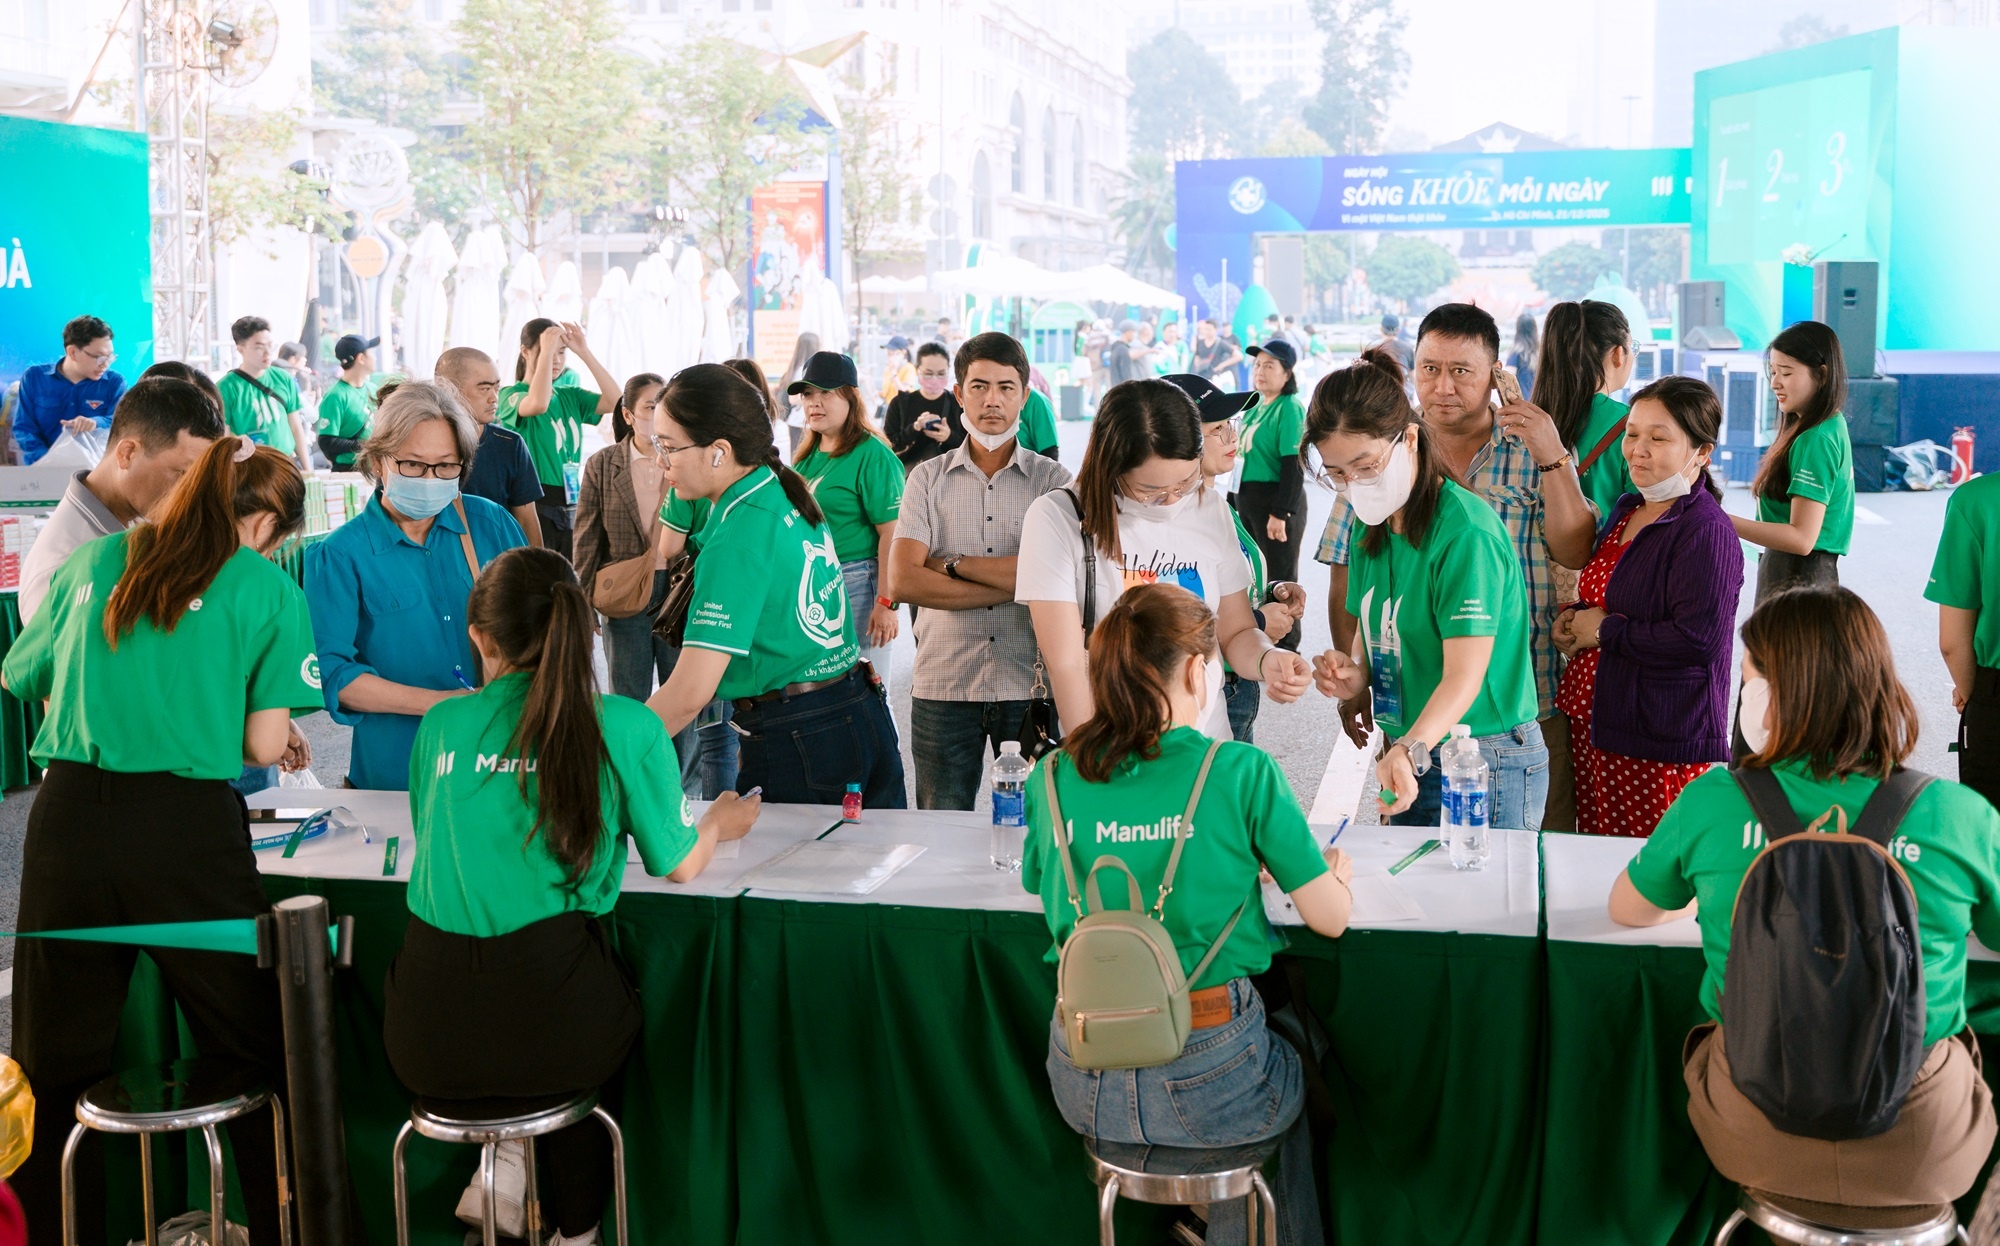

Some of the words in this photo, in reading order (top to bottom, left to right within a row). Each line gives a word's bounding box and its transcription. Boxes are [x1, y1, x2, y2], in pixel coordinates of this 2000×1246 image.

[1762, 148, 1784, 203] 2
[1820, 131, 1847, 197] 3
[1341, 179, 1405, 207] SỐNG
[1407, 170, 1494, 206] KHỎE
[1498, 176, 1543, 204] MỖI
[1546, 176, 1611, 203] NGÀY
[1115, 549, 1198, 580] Holiday
[696, 609, 730, 620] Professional
[703, 601, 723, 611] United
[691, 618, 717, 627] Customer
[718, 620, 733, 629] First
